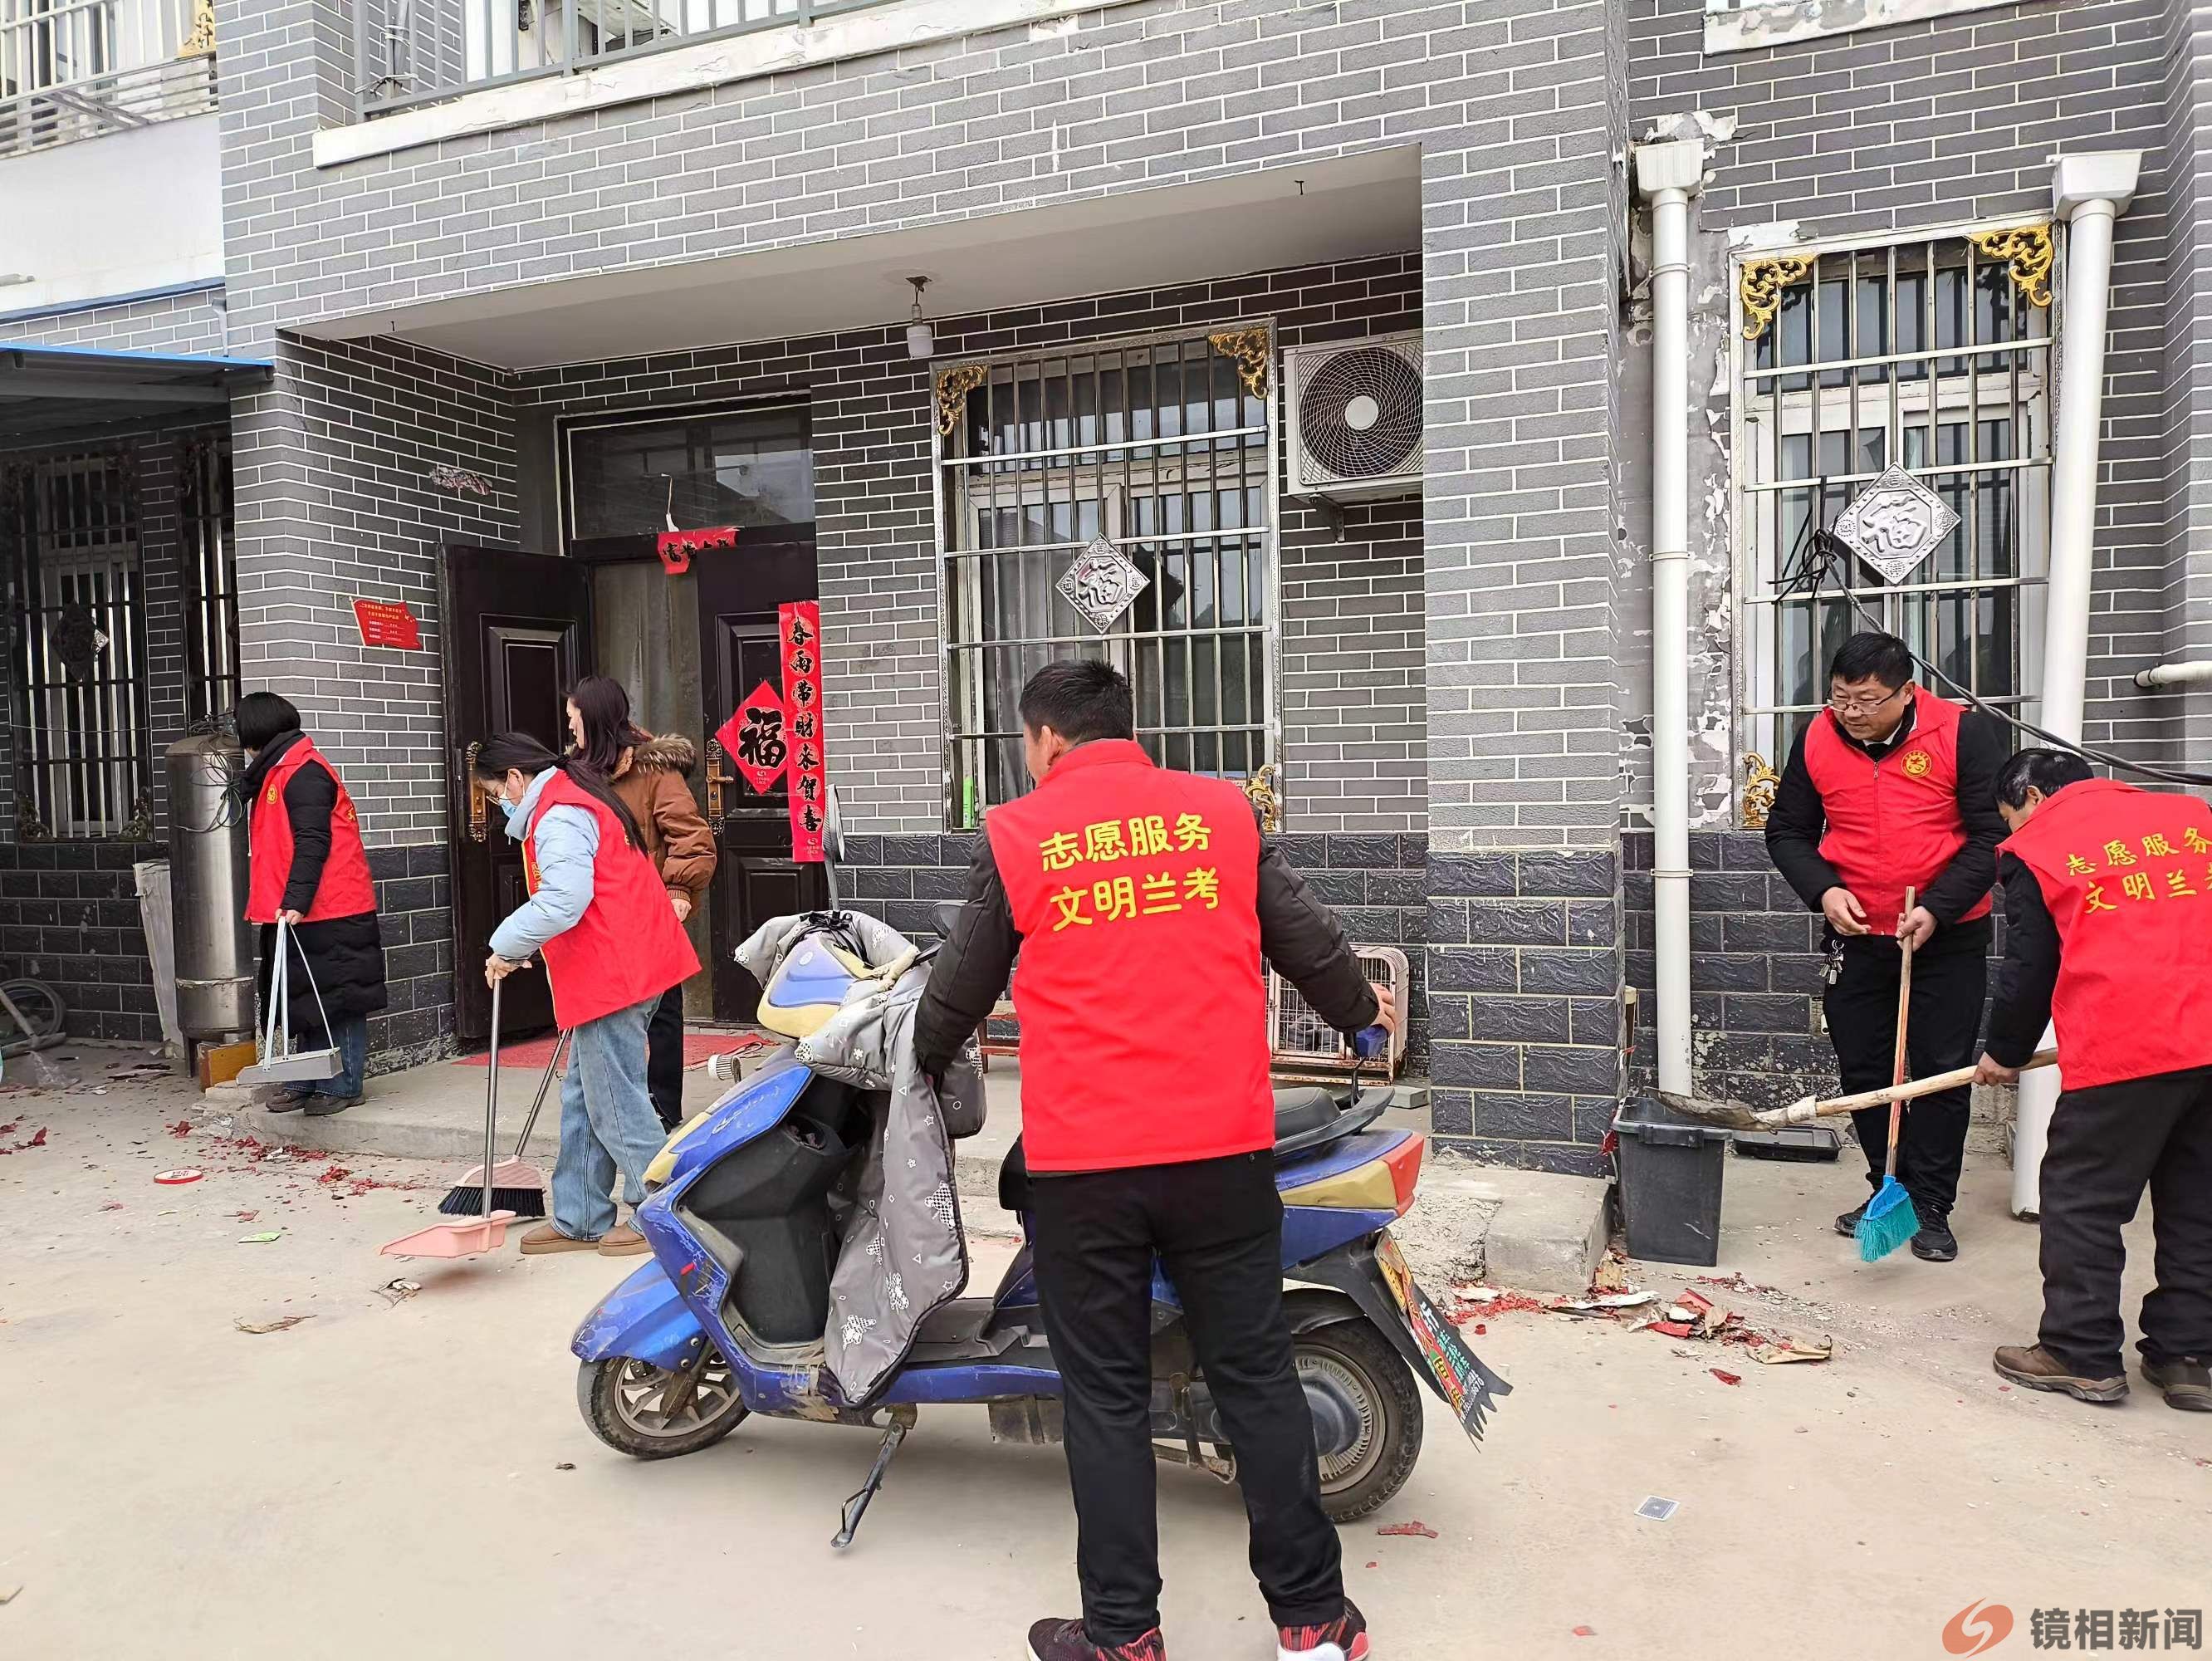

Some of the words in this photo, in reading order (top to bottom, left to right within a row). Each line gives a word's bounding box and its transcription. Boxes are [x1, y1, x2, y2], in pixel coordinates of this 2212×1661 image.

[737, 707, 787, 769] 福
[1038, 811, 1212, 872] 志愿服务
[2065, 826, 2212, 876] 志愿服务
[1049, 866, 1220, 933] 文明兰考
